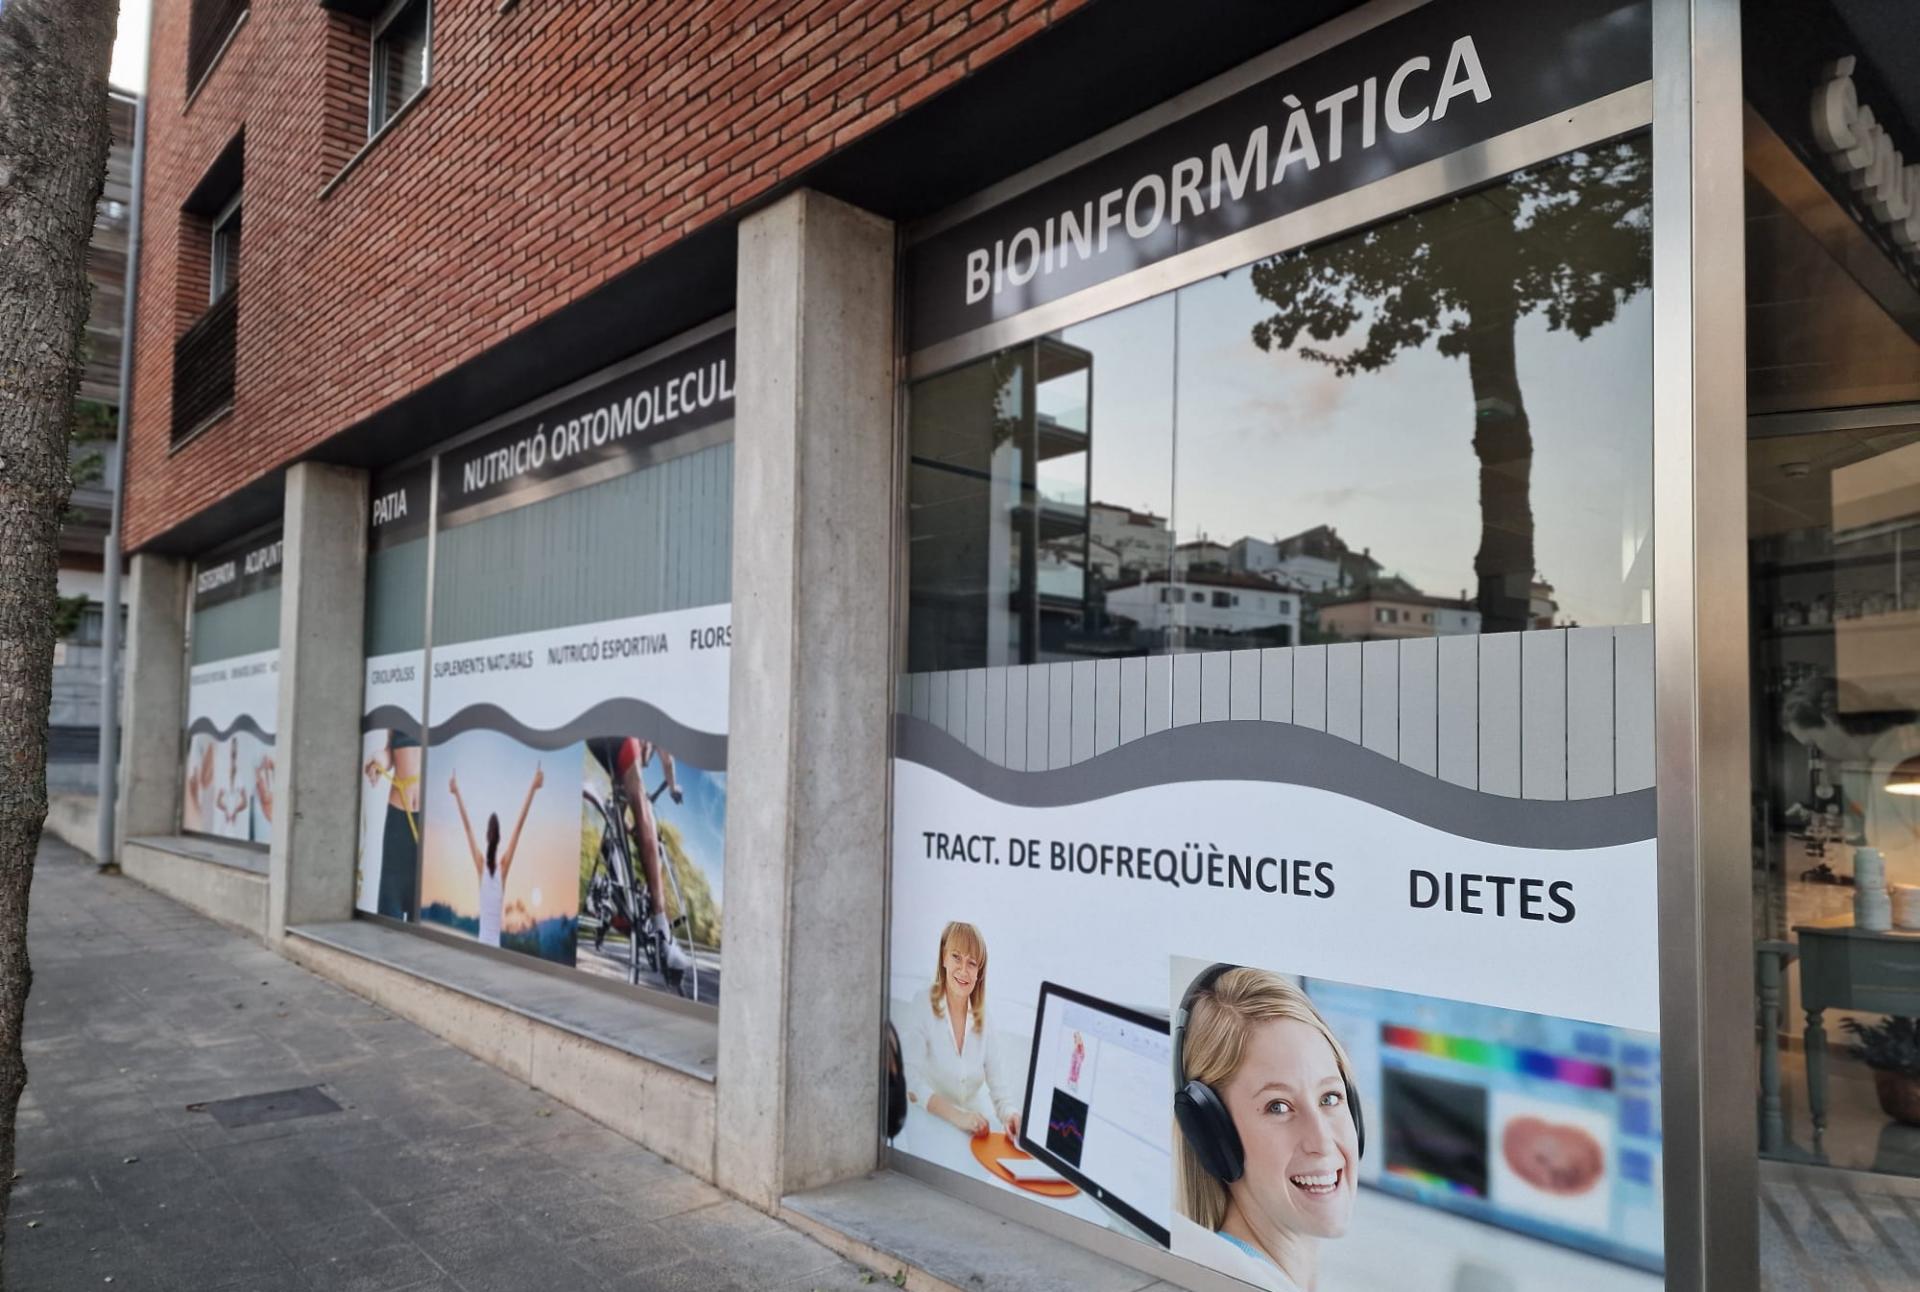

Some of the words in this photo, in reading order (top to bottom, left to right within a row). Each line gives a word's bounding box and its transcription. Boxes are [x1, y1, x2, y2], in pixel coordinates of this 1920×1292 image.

[965, 35, 1492, 305] BIOINFORMÀTICA
[463, 423, 546, 494] NUTRICIÓ
[550, 359, 736, 461] ORTOMOLECUL
[373, 488, 407, 527] PATIA
[433, 657, 485, 679] SUPLEMENTS
[486, 651, 534, 673] NATURALS
[548, 640, 600, 666] NUTRICIÓ
[602, 633, 669, 660] ESPORTIVA
[922, 831, 1000, 866] TRACT.
[1008, 837, 1041, 869] DE
[1049, 841, 1336, 899] BIOFREQÜÈNCIES
[1408, 869, 1577, 924] DIETES
